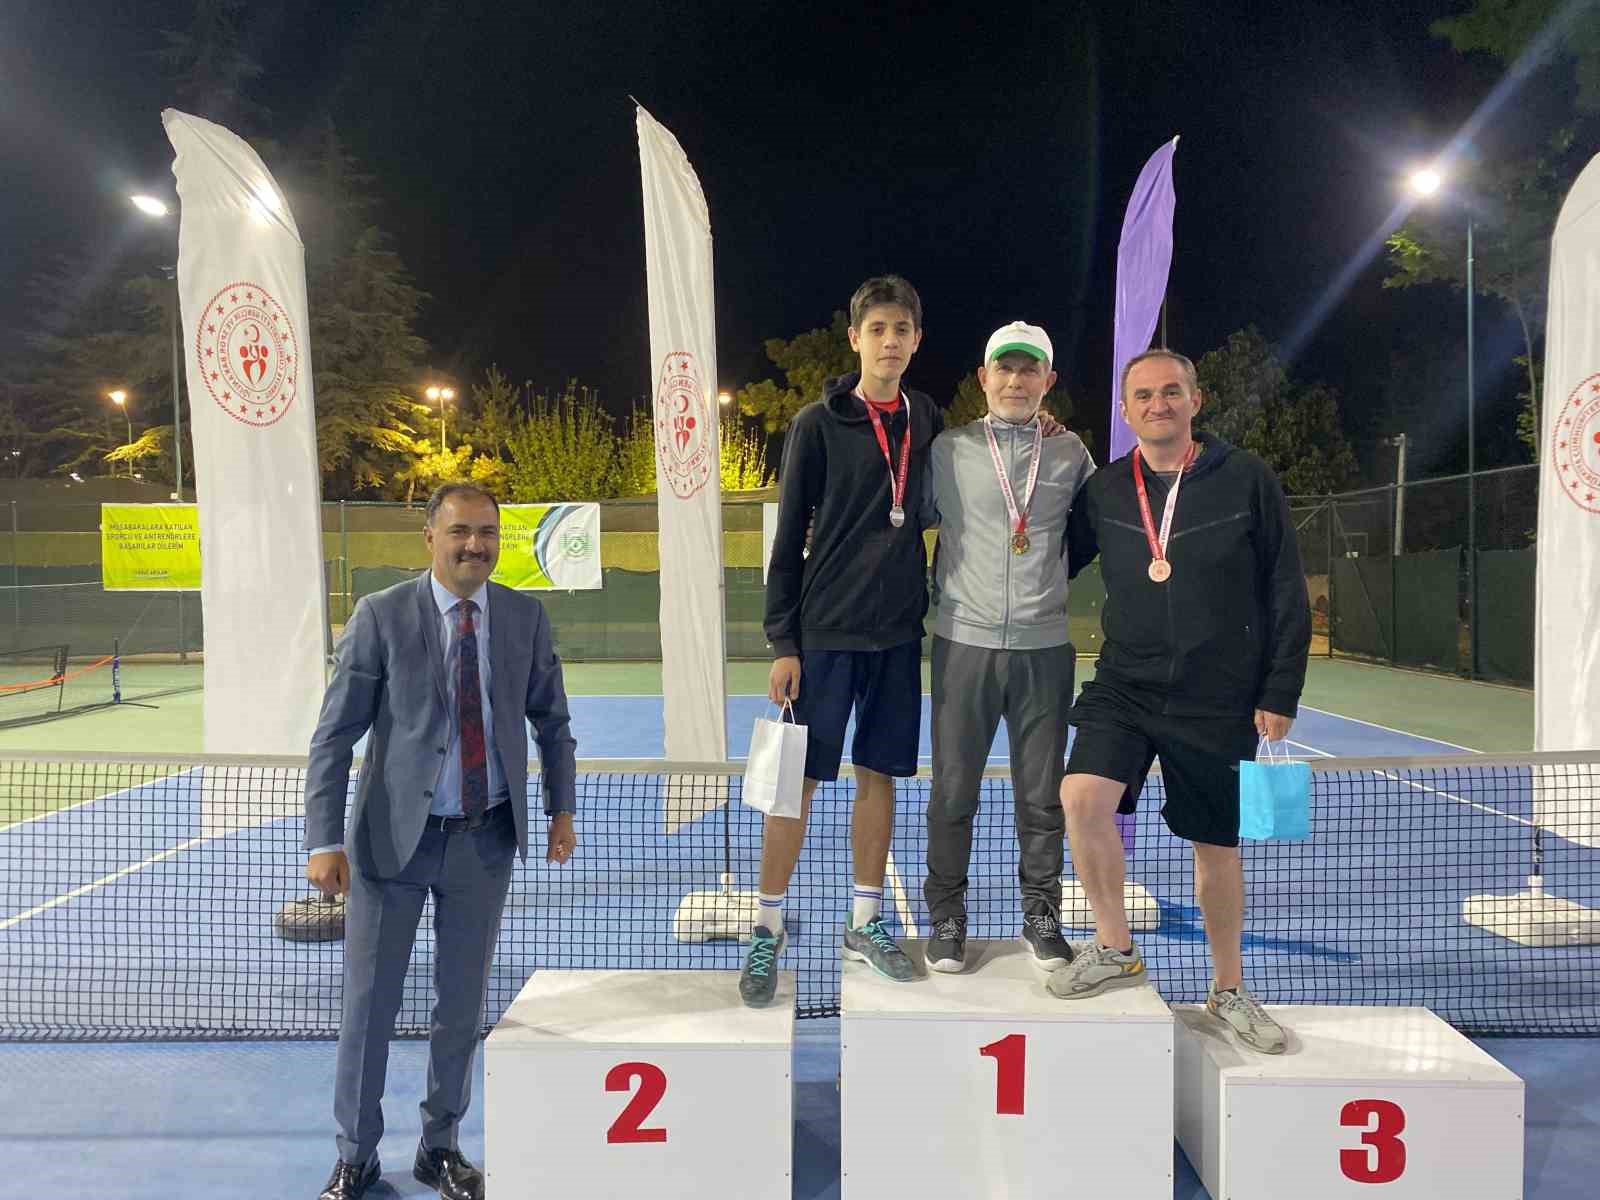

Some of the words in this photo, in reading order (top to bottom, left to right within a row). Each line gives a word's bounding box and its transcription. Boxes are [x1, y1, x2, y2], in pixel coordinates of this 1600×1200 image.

[605, 1062, 667, 1144] 2
[979, 1034, 1026, 1115] 1
[1340, 1099, 1406, 1184] 3
